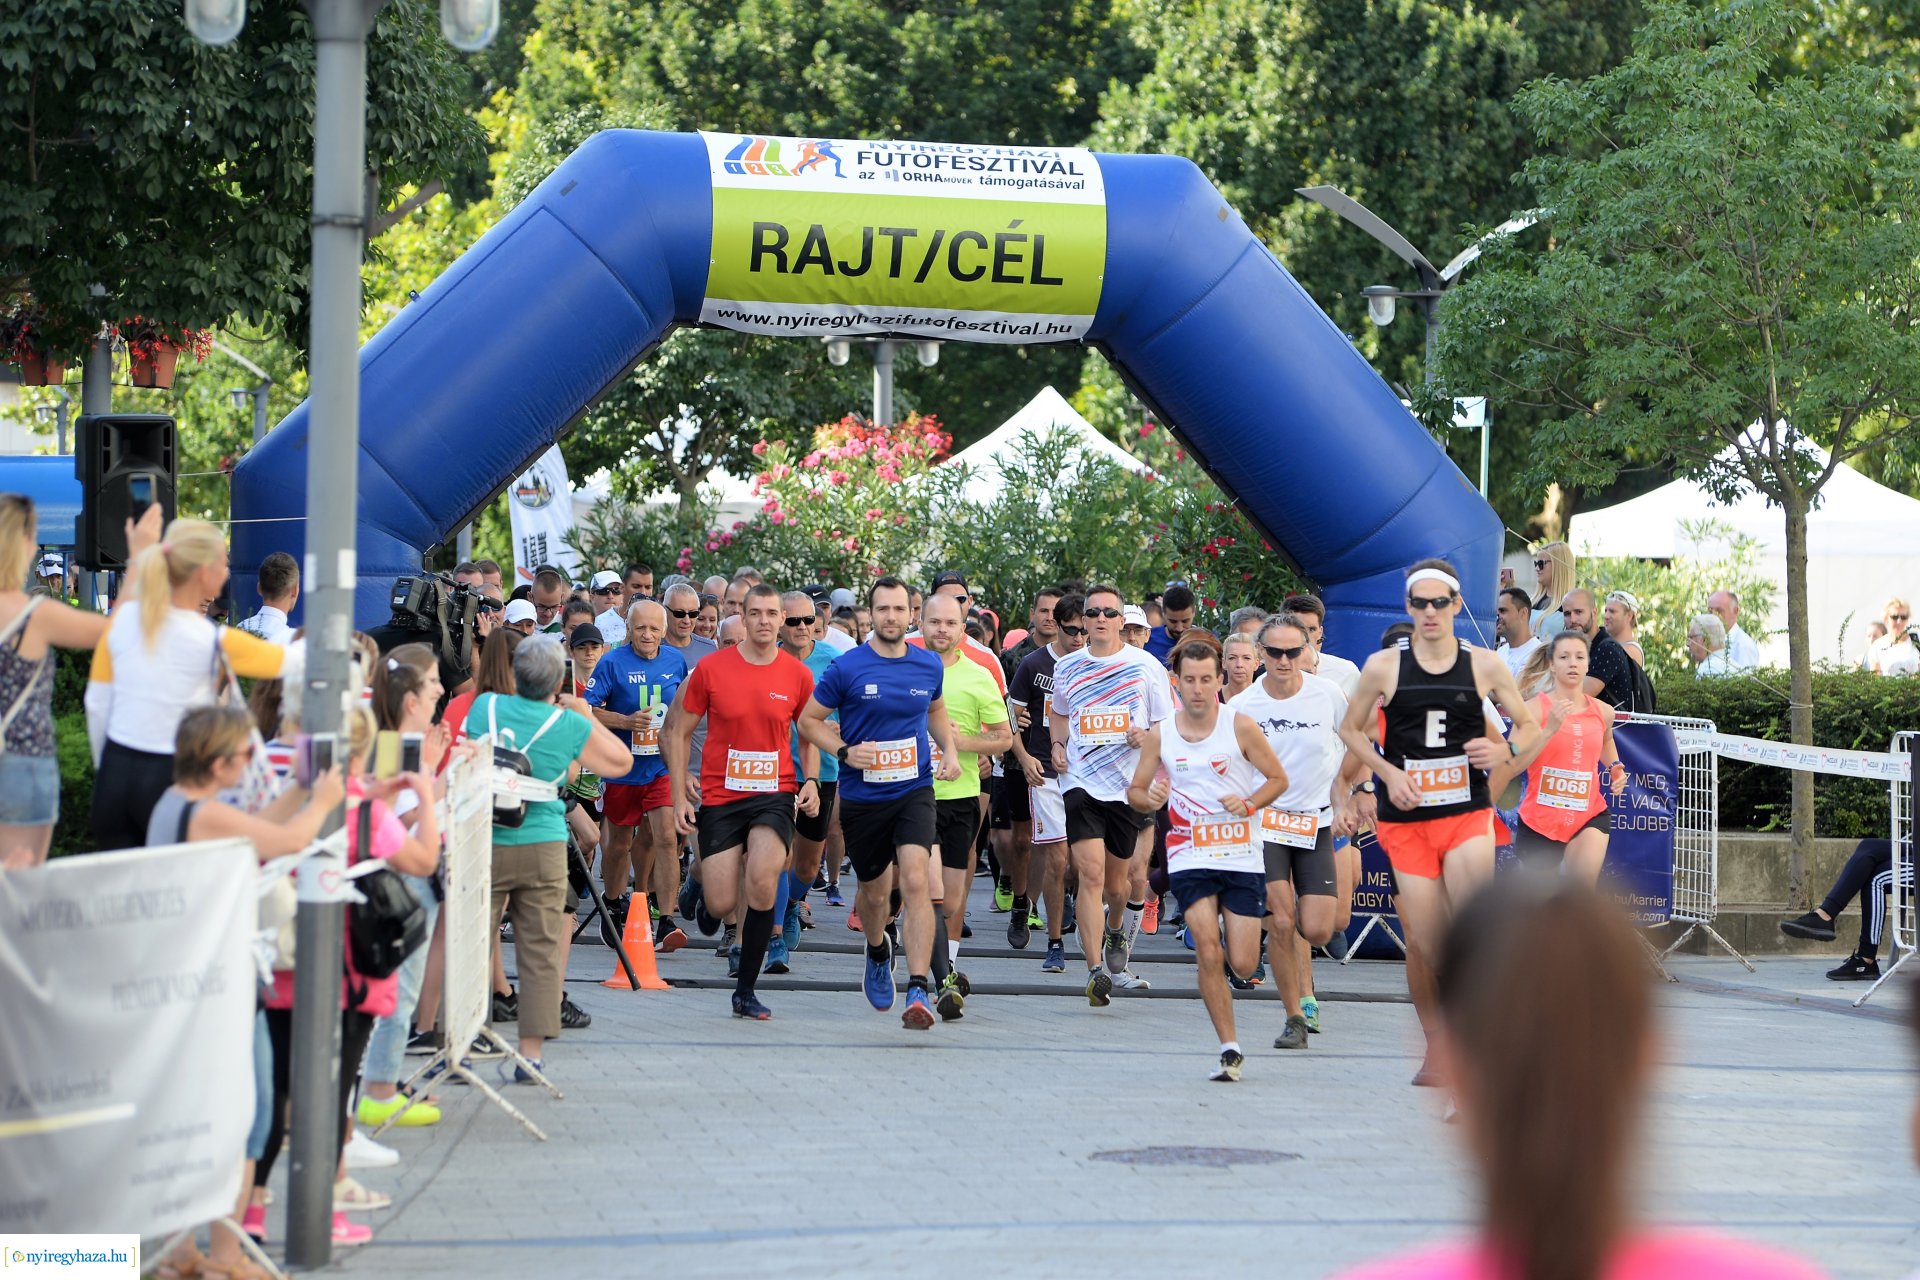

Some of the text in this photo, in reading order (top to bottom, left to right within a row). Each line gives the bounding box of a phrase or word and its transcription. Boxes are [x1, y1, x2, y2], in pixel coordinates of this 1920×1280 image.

[857, 151, 1084, 176] FUTÓFESZTIVÁL
[858, 171, 875, 180] az
[980, 174, 1085, 190] támogatásával
[749, 219, 1063, 286] RAJT/CÉL
[717, 308, 1073, 336] www.nyiregyhazifutofesztival.hu
[628, 674, 646, 684] NN
[1083, 714, 1125, 729] 1078
[1425, 710, 1447, 747] E
[732, 760, 774, 775] 1129
[1412, 767, 1463, 787] 1149
[1546, 777, 1588, 795] 1068
[1631, 793, 1669, 811] VAGY
[1267, 810, 1313, 831] 1025
[1197, 823, 1246, 841] 1100
